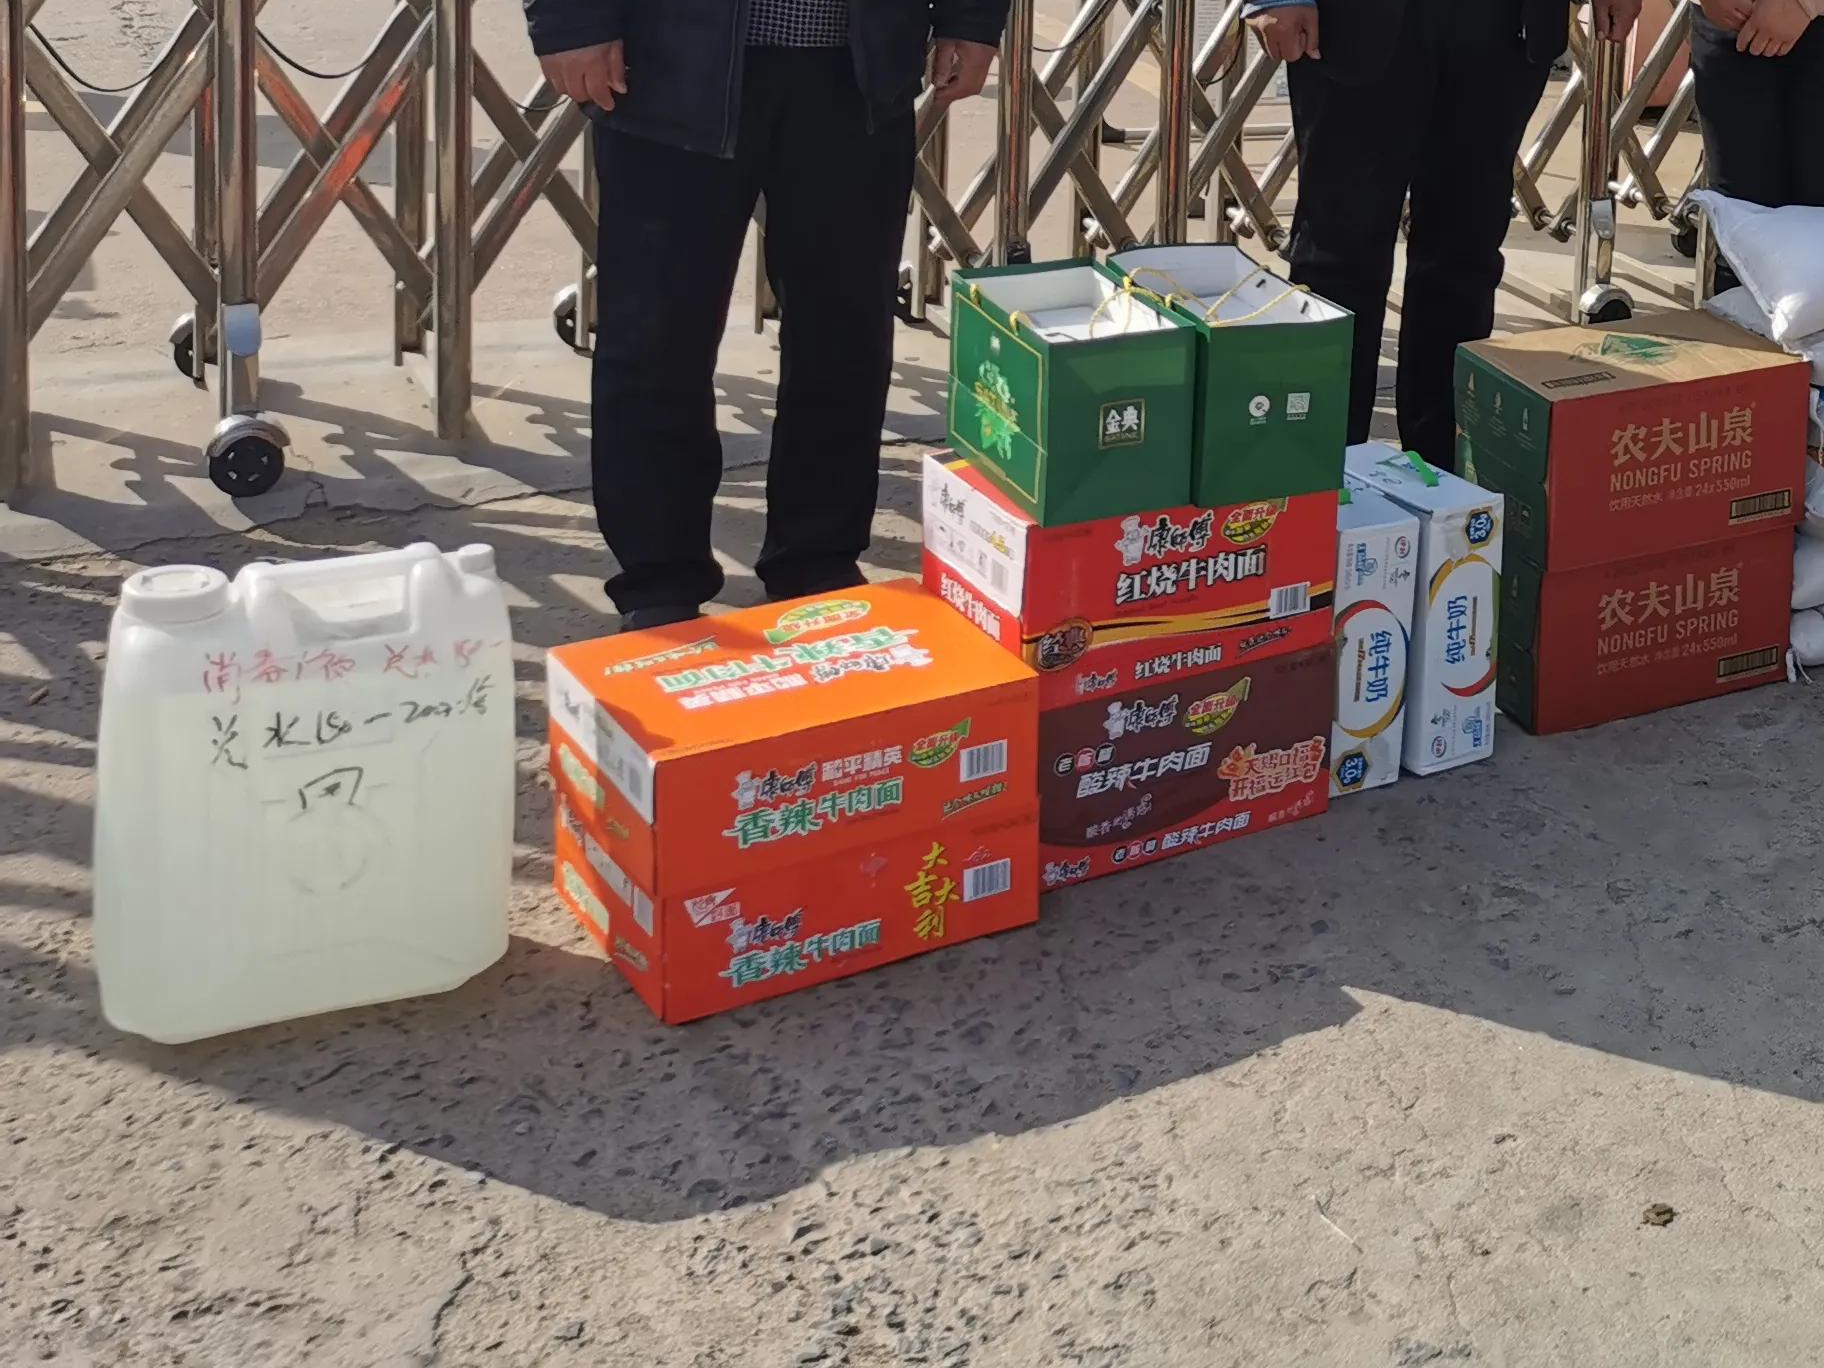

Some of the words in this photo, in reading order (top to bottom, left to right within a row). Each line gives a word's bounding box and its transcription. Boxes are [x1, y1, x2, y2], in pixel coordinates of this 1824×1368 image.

[1104, 405, 1140, 436] 金典
[1609, 405, 1755, 467] 农夫山泉
[1609, 461, 1682, 493] NONGFU
[1688, 450, 1752, 483] SPRING
[939, 571, 1002, 642] 红烧牛肉面
[1115, 545, 1268, 606] 红烧牛肉面
[1597, 566, 1741, 631] 农夫山泉
[1135, 642, 1222, 680] 红烧牛肉面
[1446, 595, 1468, 665] 纯牛奶
[1597, 624, 1669, 657] NONGFU
[1675, 608, 1739, 640] SPRING
[1365, 630, 1393, 703] 纯牛奶
[1076, 742, 1212, 799] 酸辣牛肉面
[722, 777, 905, 849] 香辣牛肉面
[1161, 811, 1252, 850] 酸辣牛肉面
[904, 841, 961, 941] 大吉大利
[718, 918, 882, 989] 香辣牛肉面
